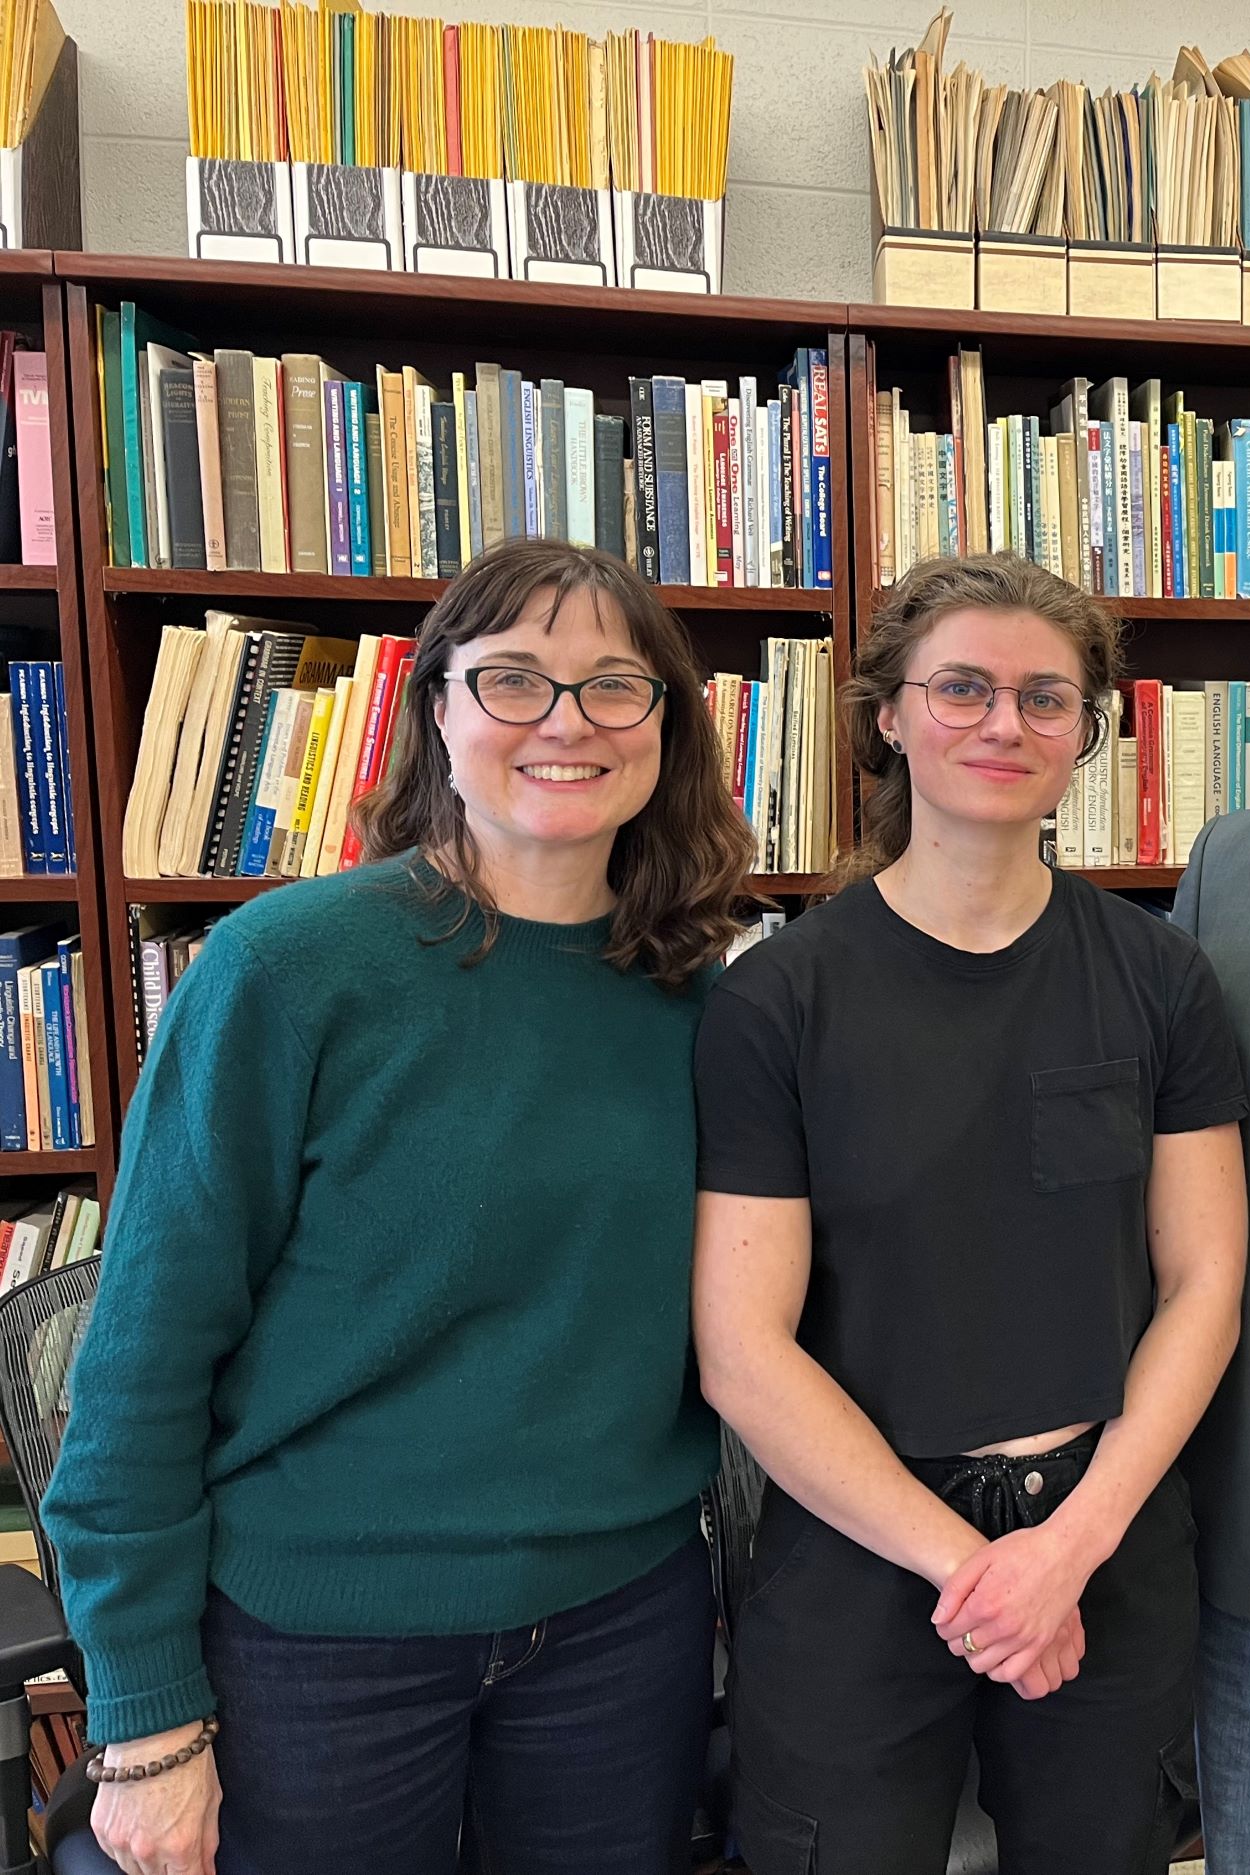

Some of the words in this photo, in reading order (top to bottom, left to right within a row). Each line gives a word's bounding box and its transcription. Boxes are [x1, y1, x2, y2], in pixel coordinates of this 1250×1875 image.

[291, 385, 316, 399] Prose
[330, 388, 339, 424] WRITING
[350, 389, 358, 424] WRITING
[523, 388, 532, 425] ENGLISH
[813, 368, 827, 416] REAL
[636, 415, 642, 424] AN
[744, 388, 753, 428] Discovering
[782, 416, 791, 431] The
[332, 424, 340, 442] AND
[390, 431, 398, 459] Concise
[636, 424, 644, 459] ADVANCED
[642, 415, 652, 446] FORM
[729, 415, 738, 447] One
[745, 428, 754, 454] English
[782, 432, 791, 454] Plural
[333, 442, 343, 484] LANGUAGE
[353, 442, 361, 484] LANGUAGE
[525, 427, 534, 480] LINGUISTICS
[569, 437, 578, 485] HANDBOOK
[643, 448, 653, 472] AND
[782, 462, 791, 475] The
[391, 461, 400, 482] Usage
[637, 459, 645, 491] RHETORIC
[719, 452, 727, 487] LANGUAGE
[731, 463, 740, 494] One
[746, 455, 754, 487] Grammar
[817, 466, 826, 482] The
[392, 484, 400, 498] and
[645, 473, 656, 531] SUBSTANCE
[782, 475, 792, 506] Teaching
[816, 482, 827, 512] College
[392, 499, 401, 529] Abusage
[732, 496, 741, 535] Learning
[746, 497, 754, 520] Richard
[784, 506, 792, 514] of
[782, 514, 793, 542] Writing
[818, 512, 827, 537] Board
[258, 640, 272, 669] GRAMMAR
[18, 669, 27, 699] PEARSON
[38, 669, 48, 699] PEARSON
[258, 669, 266, 677] IN
[372, 672, 387, 705] BUILDING
[252, 678, 265, 704] CONTEXT
[727, 680, 737, 716] RESEARCH
[19, 704, 31, 752] Introduction
[40, 704, 52, 752] Introduction
[366, 706, 381, 736] ENGLISH
[726, 718, 734, 730] ON
[1213, 693, 1221, 736] ENGLISH
[25, 752, 33, 761] to
[46, 752, 54, 761] to
[304, 732, 320, 771] LINGUISTICS
[360, 737, 376, 780] STRUCTURES
[25, 762, 37, 800] linguistic
[45, 762, 57, 800] linguistic
[302, 772, 312, 785] AND
[757, 766, 765, 786] Minority
[1213, 740, 1221, 795] LANGUAGE
[298, 786, 311, 812] READING
[1072, 787, 1082, 832] Introduction
[1088, 794, 1096, 832] ENGLISH
[1098, 789, 1109, 832] Introduction
[27, 800, 39, 835] concepts
[47, 800, 59, 835] concepts
[141, 949, 162, 990] Child
[4, 980, 16, 1015] Linguistic
[5, 1016, 16, 1045] Change
[46, 1023, 52, 1031] OF
[8, 1046, 17, 1060] and
